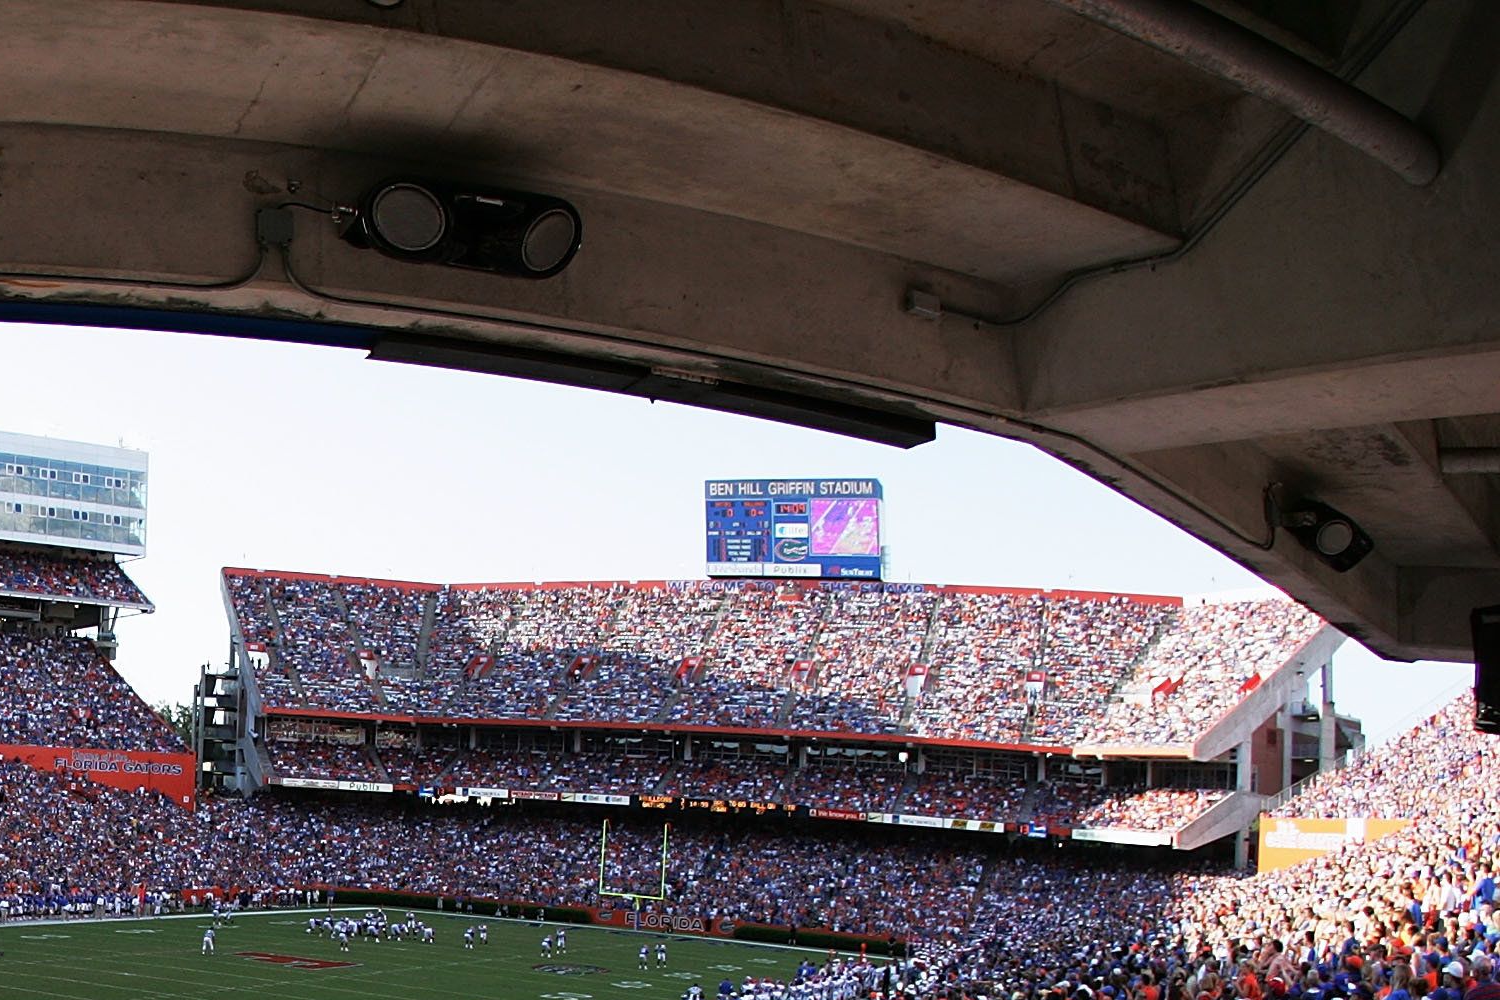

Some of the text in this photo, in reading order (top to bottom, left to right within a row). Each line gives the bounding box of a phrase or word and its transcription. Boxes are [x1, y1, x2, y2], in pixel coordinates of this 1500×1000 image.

[709, 481, 873, 495] BEN HILL GRIFFIN STADIUM
[773, 565, 808, 575] Publix
[754, 582, 775, 592] TO
[819, 581, 850, 592] THE
[54, 758, 182, 775] FLORIDA GATORS
[349, 783, 380, 791] Publix
